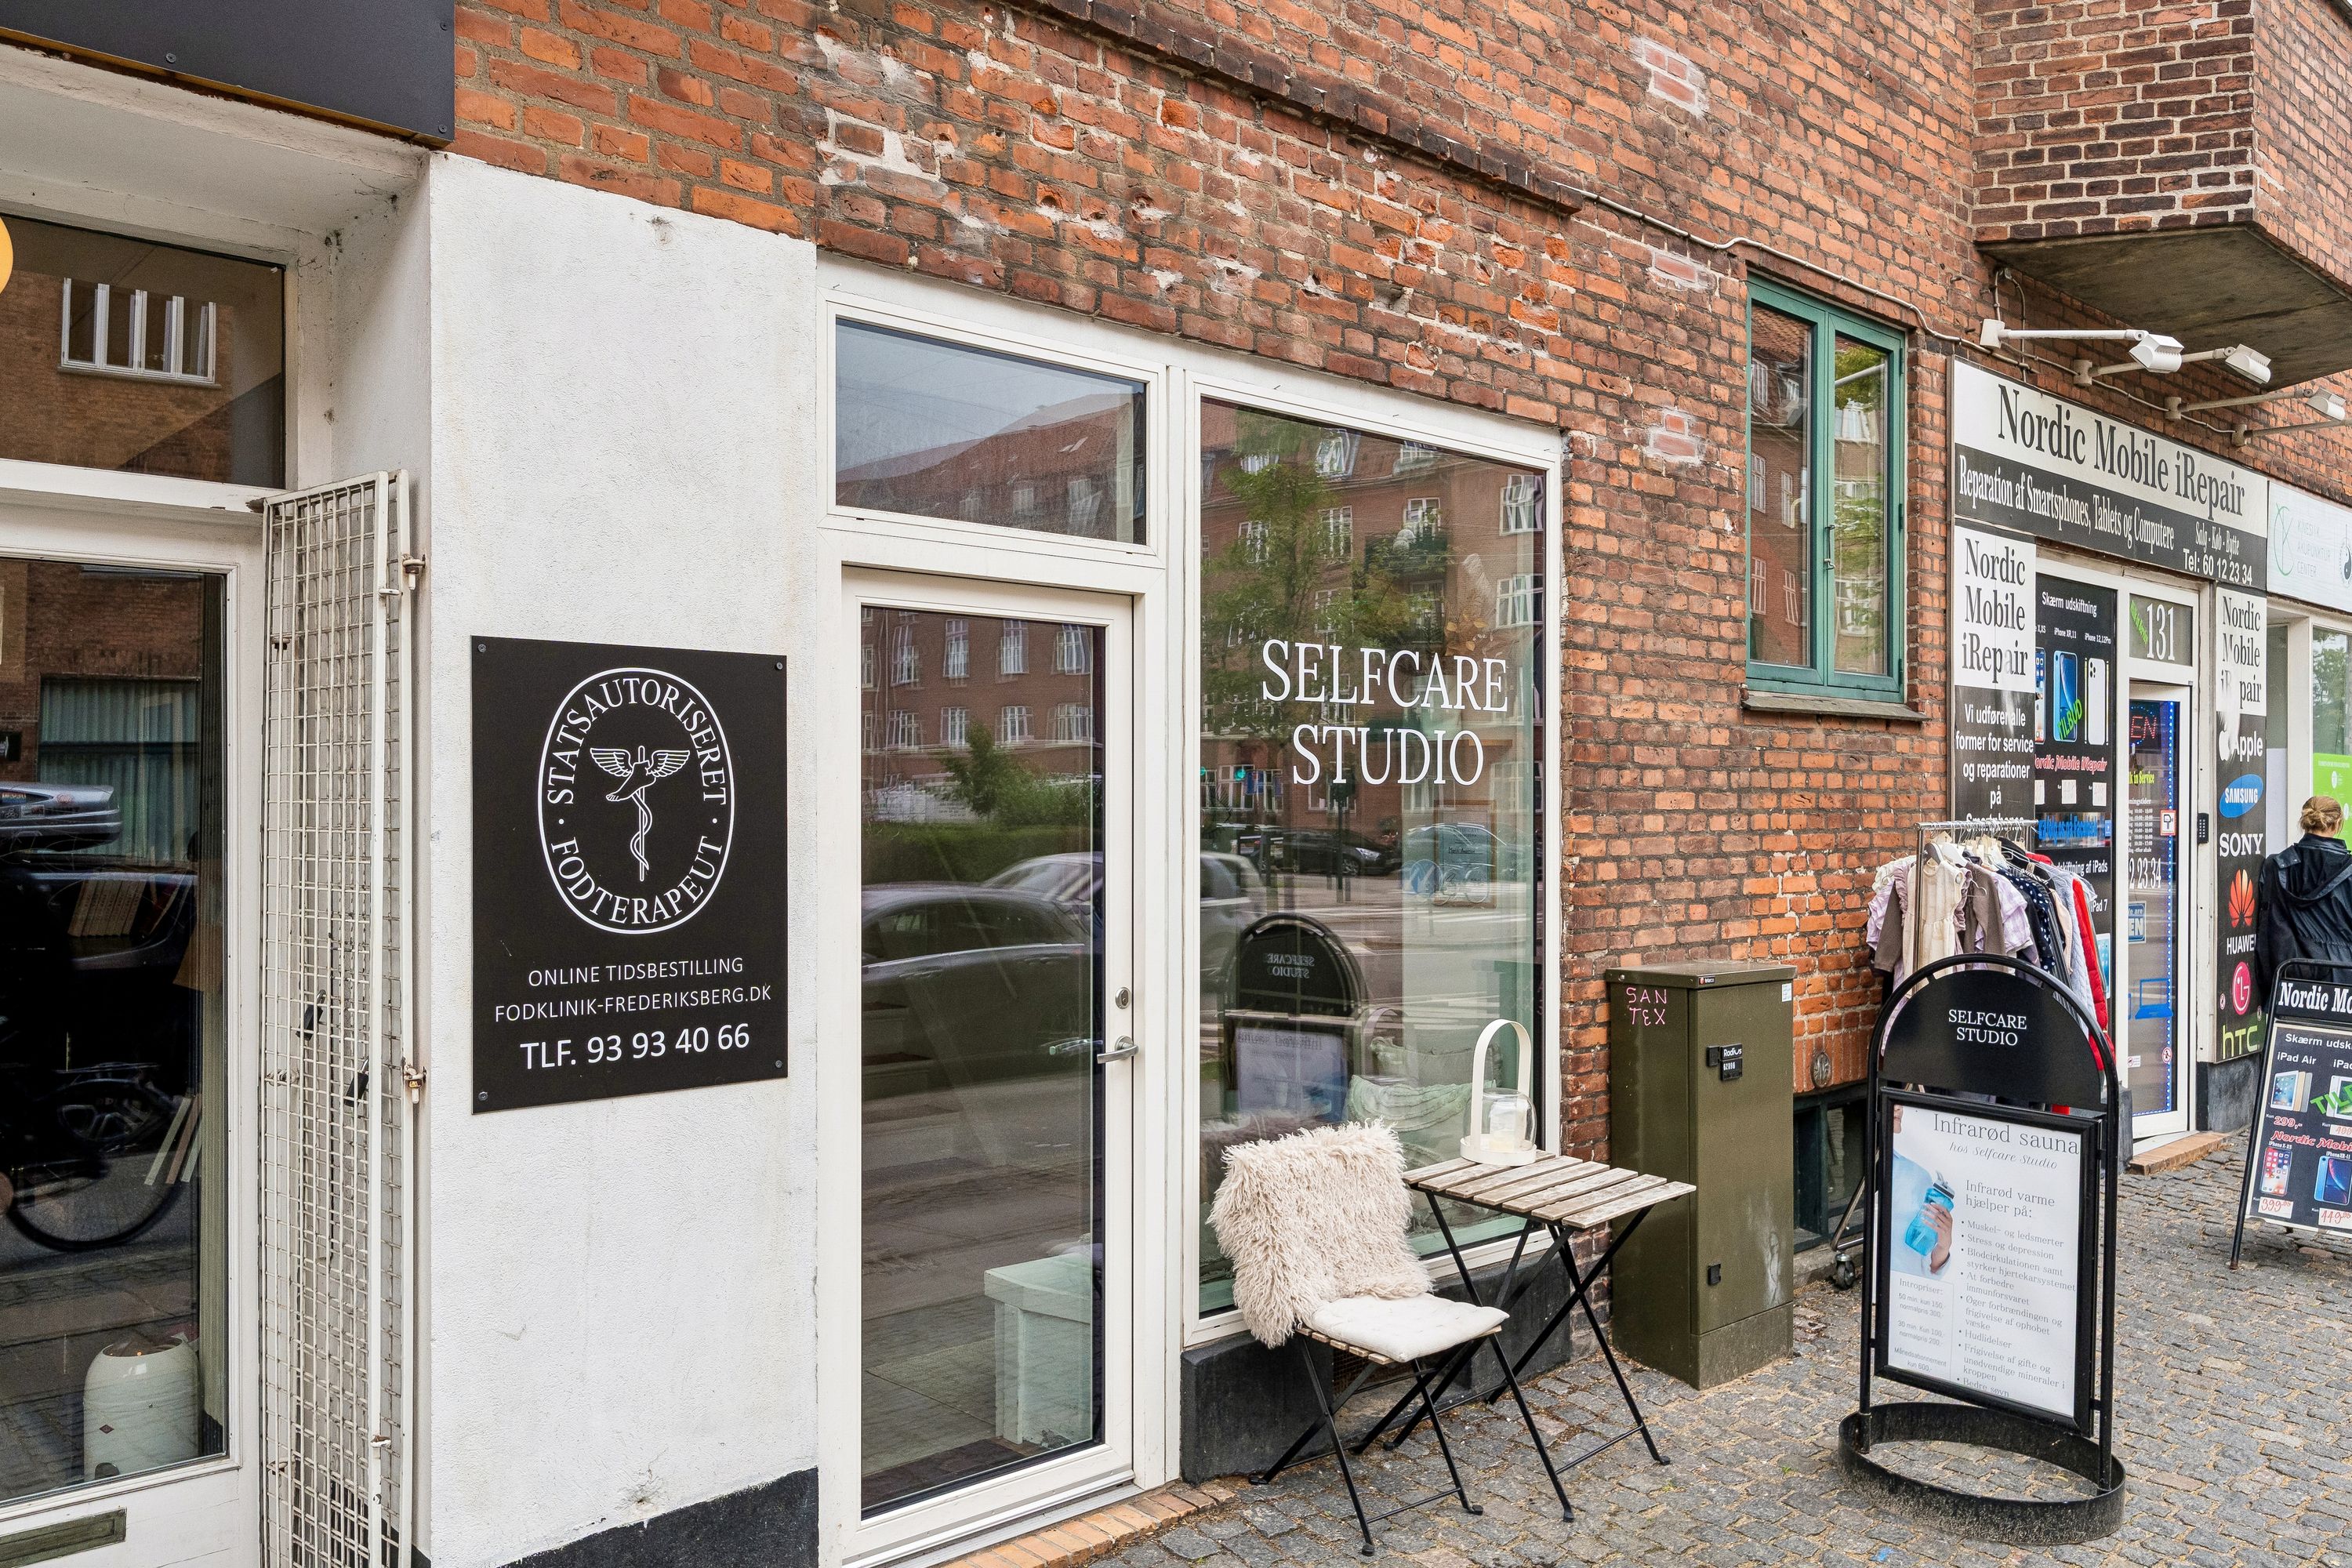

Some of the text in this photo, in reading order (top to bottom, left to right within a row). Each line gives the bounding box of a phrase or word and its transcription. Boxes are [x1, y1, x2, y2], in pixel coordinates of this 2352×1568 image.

[1998, 383, 2245, 521] Nordic Mobile iRepair
[1960, 456, 2175, 554] Reparation af Smartsphones, Tablets og Computere
[2195, 521, 2241, 560] Salg Køb Bytte
[1965, 538, 2026, 586] Nordic
[2183, 549, 2252, 586] Tel: 60 12 23 34
[1965, 585, 2026, 631] Mobile
[2042, 591, 2097, 618] Skærm udskiftning
[2223, 596, 2261, 632] Nordic
[2053, 627, 2066, 637] iPhone
[2084, 633, 2096, 642] iPhone
[2147, 603, 2175, 661] 131
[1962, 632, 2028, 684] iRepair
[2223, 633, 2260, 667] Mobile
[1262, 639, 1508, 712] SELFCARE
[1964, 703, 2026, 728] Vi udfører alle
[2057, 699, 2082, 740] TILBUD
[2130, 716, 2157, 739] EN
[548, 677, 726, 806] STATSAUTORISERET
[1955, 730, 2034, 753] former for service
[1293, 724, 1484, 786] STUDIO
[2034, 754, 2107, 775] ordic Mobile iRepair
[1962, 760, 2031, 782] og reparationer
[1990, 785, 2002, 809] på
[2224, 786, 2259, 805] SAMSUNG
[2219, 832, 2263, 857] SONY
[2085, 859, 2107, 873] af iPads
[2137, 857, 2161, 889] 23 34
[551, 836, 722, 925] FODTERAPEUT
[2104, 899, 2108, 911] 7
[2129, 917, 2143, 936] EN
[528, 957, 744, 987] ONLINE TIDSBESTILLING
[495, 985, 771, 1022] FODKLINIK-FREDERIKSBERG.DK
[1626, 987, 1667, 1004] SAN
[2278, 982, 2328, 1011] Nordic
[1628, 1007, 1666, 1026] TEX
[1948, 1008, 2027, 1030] SELFCARE
[520, 1022, 750, 1071] TLF. 93 93 40 66
[1956, 1027, 2018, 1047] STUDIO
[2285, 1033, 2352, 1051] Skærm udsk
[1723, 1048, 1742, 1058] Radius
[2278, 1051, 2299, 1062] iPad
[2302, 1055, 2317, 1065] Air
[1934, 1114, 2079, 1155] Infrarød sauna
[2270, 1131, 2316, 1145] Nordic
[1949, 1142, 2058, 1169] hos Selfcare Studio
[1965, 1194, 2032, 1218] hjælper på:
[1966, 1180, 2055, 1207] Infrarød varme
[1967, 1220, 2064, 1248] Muskel- og ledsmerter
[1967, 1234, 2054, 1260] Stress og depression
[1967, 1247, 2063, 1277] Blodcirkulationen samt
[1900, 1278, 1944, 1295] Intropriser:
[1966, 1260, 2077, 1292] styrker hjertekarsystemet
[1966, 1272, 2015, 1290] At forbedre
[1966, 1282, 2030, 1305] immunforsvaret
[1900, 1303, 1929, 1315] normalpris
[1965, 1294, 2063, 1327] Øger forbrændingen og
[1965, 1307, 2051, 1337] frigivelse af ophobet
[1965, 1319, 1991, 1331] væske
[1965, 1330, 2013, 1348] Hudlidelser
[1894, 1347, 1947, 1367] Månedsabonnement
[1964, 1343, 2051, 1374] Frigivelse af gifte og
[1963, 1365, 1997, 1382] kroppen
[1964, 1356, 2065, 1389] unødvendige mineraler i
[1963, 1377, 2009, 1397] Bedre søvn
